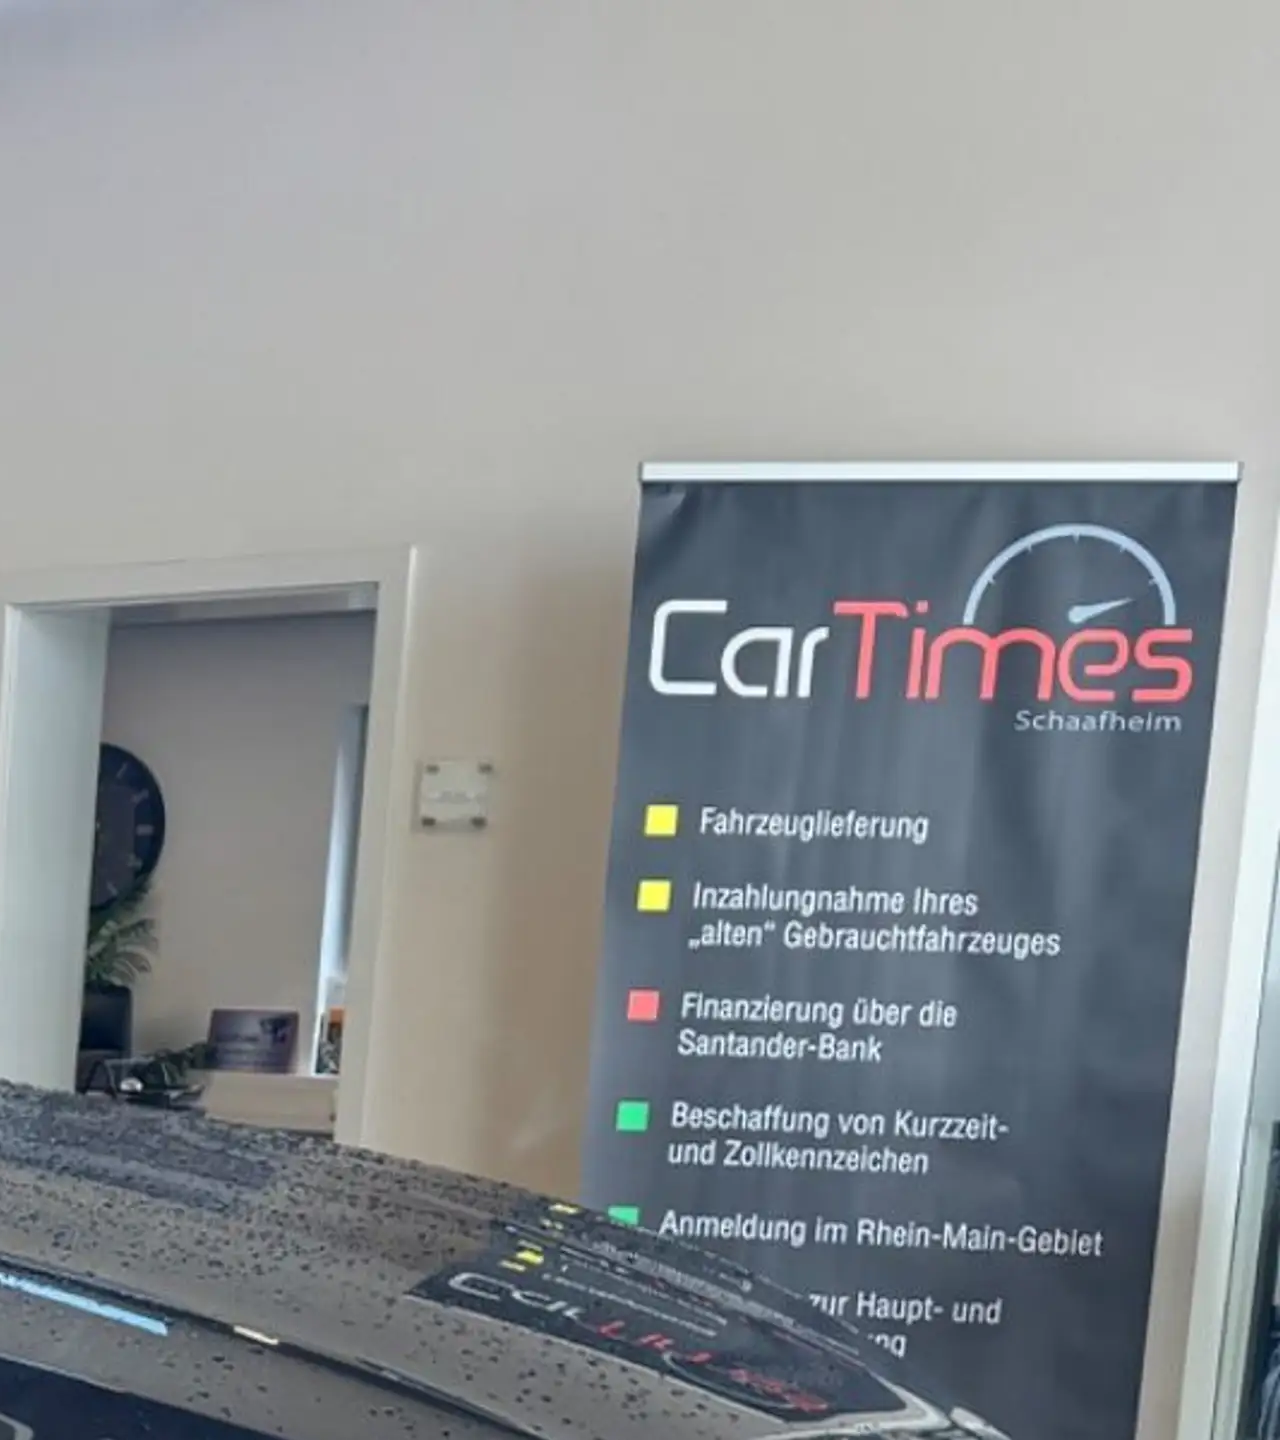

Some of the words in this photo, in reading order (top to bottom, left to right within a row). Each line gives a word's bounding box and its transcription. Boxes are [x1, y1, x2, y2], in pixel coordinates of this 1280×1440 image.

[648, 599, 1194, 703] CarTimes
[1014, 709, 1182, 733] Schaafheim
[699, 806, 929, 845] Fahrzeuglieferung
[692, 881, 905, 917] Inzahlungnahme
[913, 887, 979, 916] Ihres
[783, 921, 1062, 961] Gebrauchtfahrzeuges
[681, 992, 843, 1029] Finanzierung
[853, 998, 912, 1027] über
[920, 1000, 958, 1028] die
[677, 1028, 883, 1063] Santander-Bank
[671, 1101, 830, 1139] Beschaffung
[839, 1112, 886, 1137] von
[894, 1109, 1009, 1141] Kurzzeit-
[667, 1140, 716, 1166] und
[723, 1139, 930, 1175] Zollkennzeichen
[658, 1209, 807, 1248] Anmeldung
[815, 1216, 848, 1243] im
[857, 1219, 1104, 1257] Rhein-Main-Gebiet
[857, 1290, 944, 1326] Haupt-
[952, 1297, 1003, 1324] und
